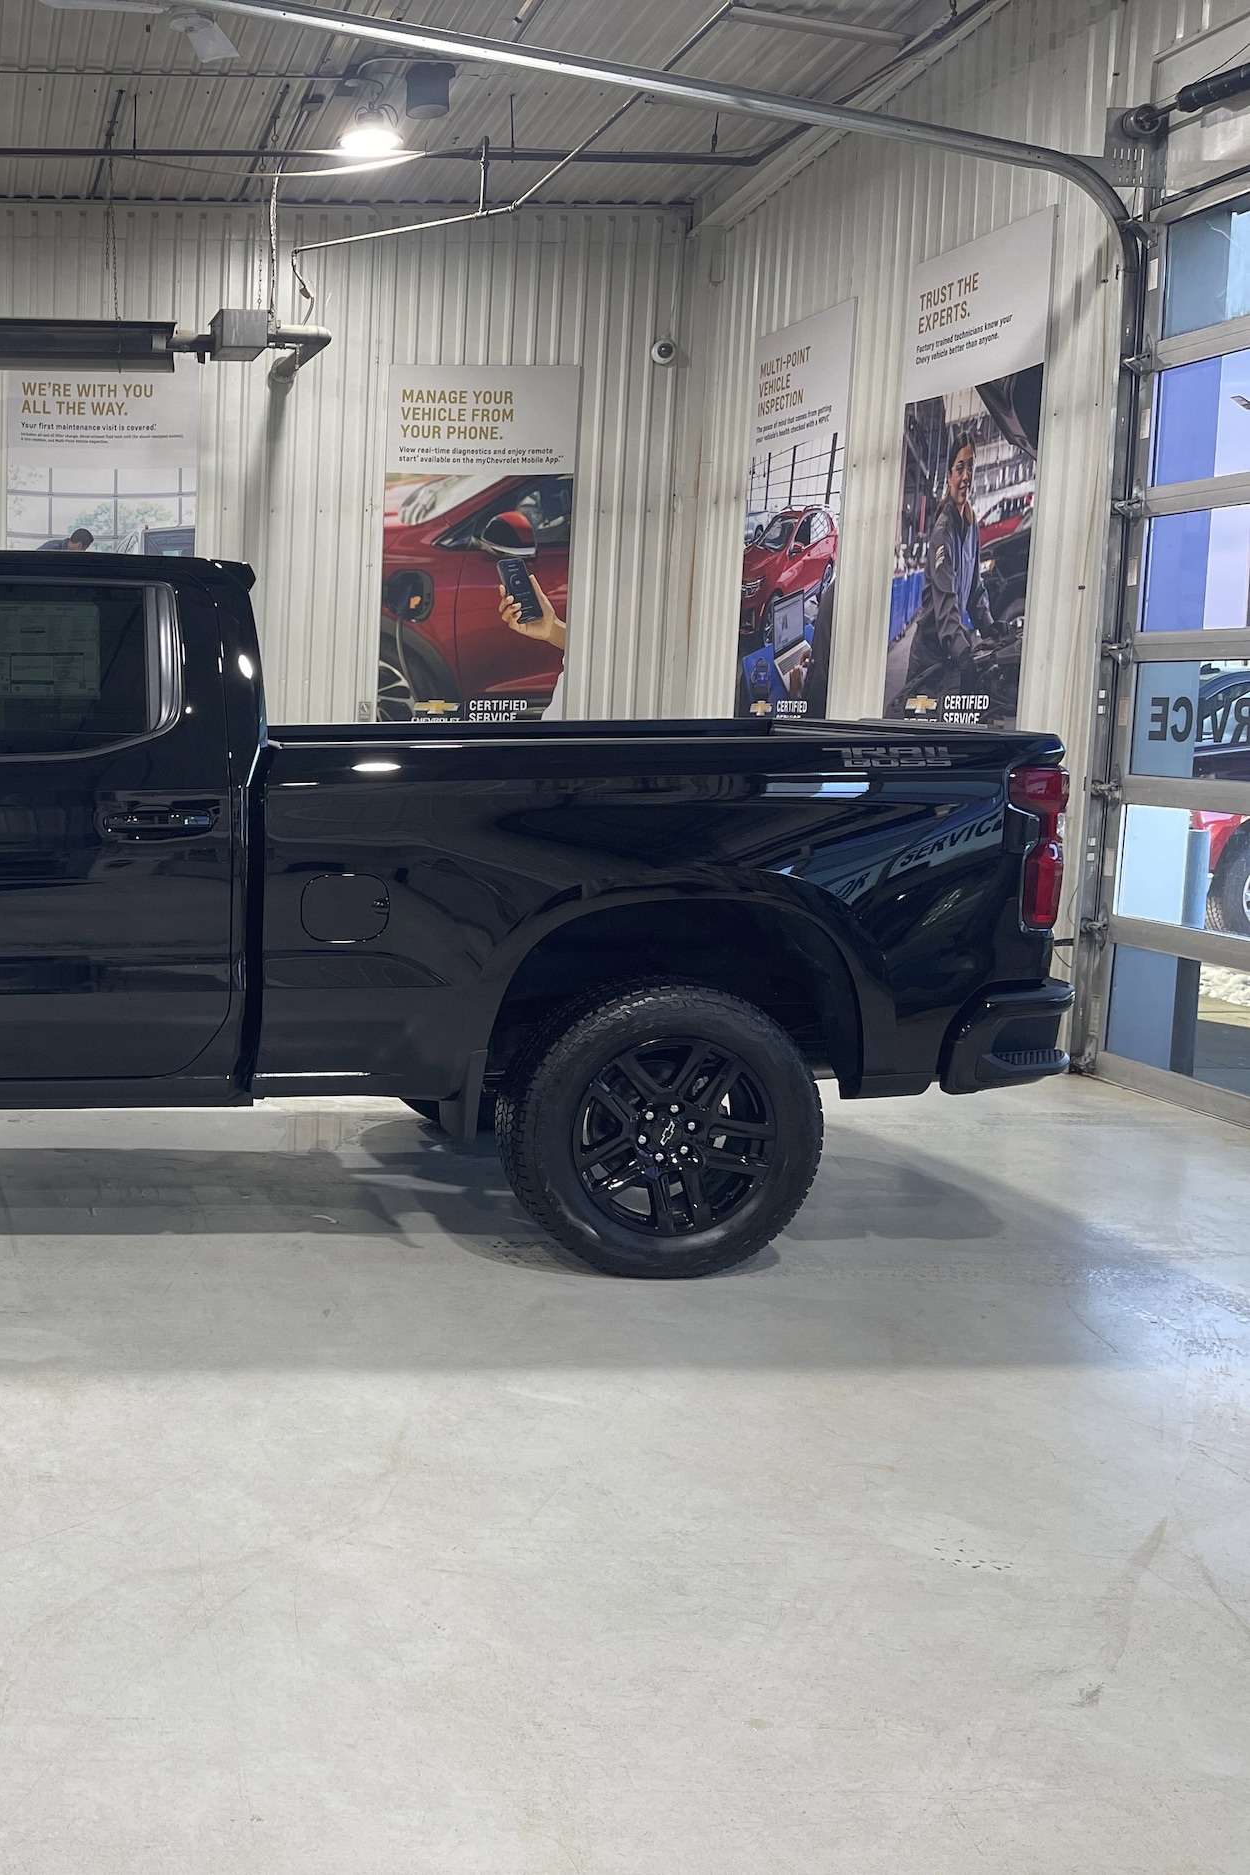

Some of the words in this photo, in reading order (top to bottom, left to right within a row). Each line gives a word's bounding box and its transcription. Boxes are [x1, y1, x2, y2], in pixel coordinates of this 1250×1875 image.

[919, 281, 954, 312] TRUST
[957, 272, 979, 297] THE
[918, 301, 970, 335] EXPERTS.
[916, 342, 935, 353] Factory
[935, 334, 953, 347] trained
[954, 325, 983, 342] technicians
[984, 321, 999, 331] know
[999, 314, 1013, 327] your
[915, 355, 930, 365] Chevy
[931, 349, 948, 360] vehicle
[949, 343, 965, 355] better
[965, 339, 978, 350] than
[978, 331, 1000, 346] anyone.
[760, 346, 811, 377] MULTI-POINT
[21, 381, 72, 398] WE'RE
[76, 383, 118, 398] WITH
[122, 384, 154, 398] YOU
[758, 374, 791, 398] VEHICLE
[402, 389, 468, 405] MANAGE
[472, 390, 514, 405] YOUR
[757, 388, 804, 418] INSPECTION
[21, 400, 51, 415] ALL
[56, 401, 86, 415] THE
[91, 402, 128, 416] WAY.
[401, 407, 467, 422] VEHICLE
[471, 408, 514, 422] FROM
[21, 421, 37, 430] Your
[38, 422, 54, 430] first
[56, 423, 101, 431] maintenance
[763, 423, 773, 433] peace
[778, 418, 787, 426] mind
[787, 416, 795, 424] that
[807, 409, 817, 418] from
[400, 424, 441, 439] YOUR
[446, 426, 504, 440] PHONE.
[755, 436, 764, 446] your
[779, 427, 790, 436] health
[790, 423, 806, 433] checked
[806, 419, 815, 428] with
[399, 446, 416, 454] View
[451, 447, 491, 456] diagnostics
[507, 448, 526, 456] enjoy
[420, 455, 451, 463] available
[462, 456, 474, 464] the
[475, 456, 520, 465] myChevrolet
[521, 456, 544, 464] Mobile
[469, 700, 528, 711] CERTIFIED
[776, 700, 807, 713] CERTIFIED
[944, 695, 989, 711] CERTIFIED
[469, 712, 517, 722] SERVICE
[943, 712, 980, 724] SERVICE
[843, 758, 952, 768] BOSS
